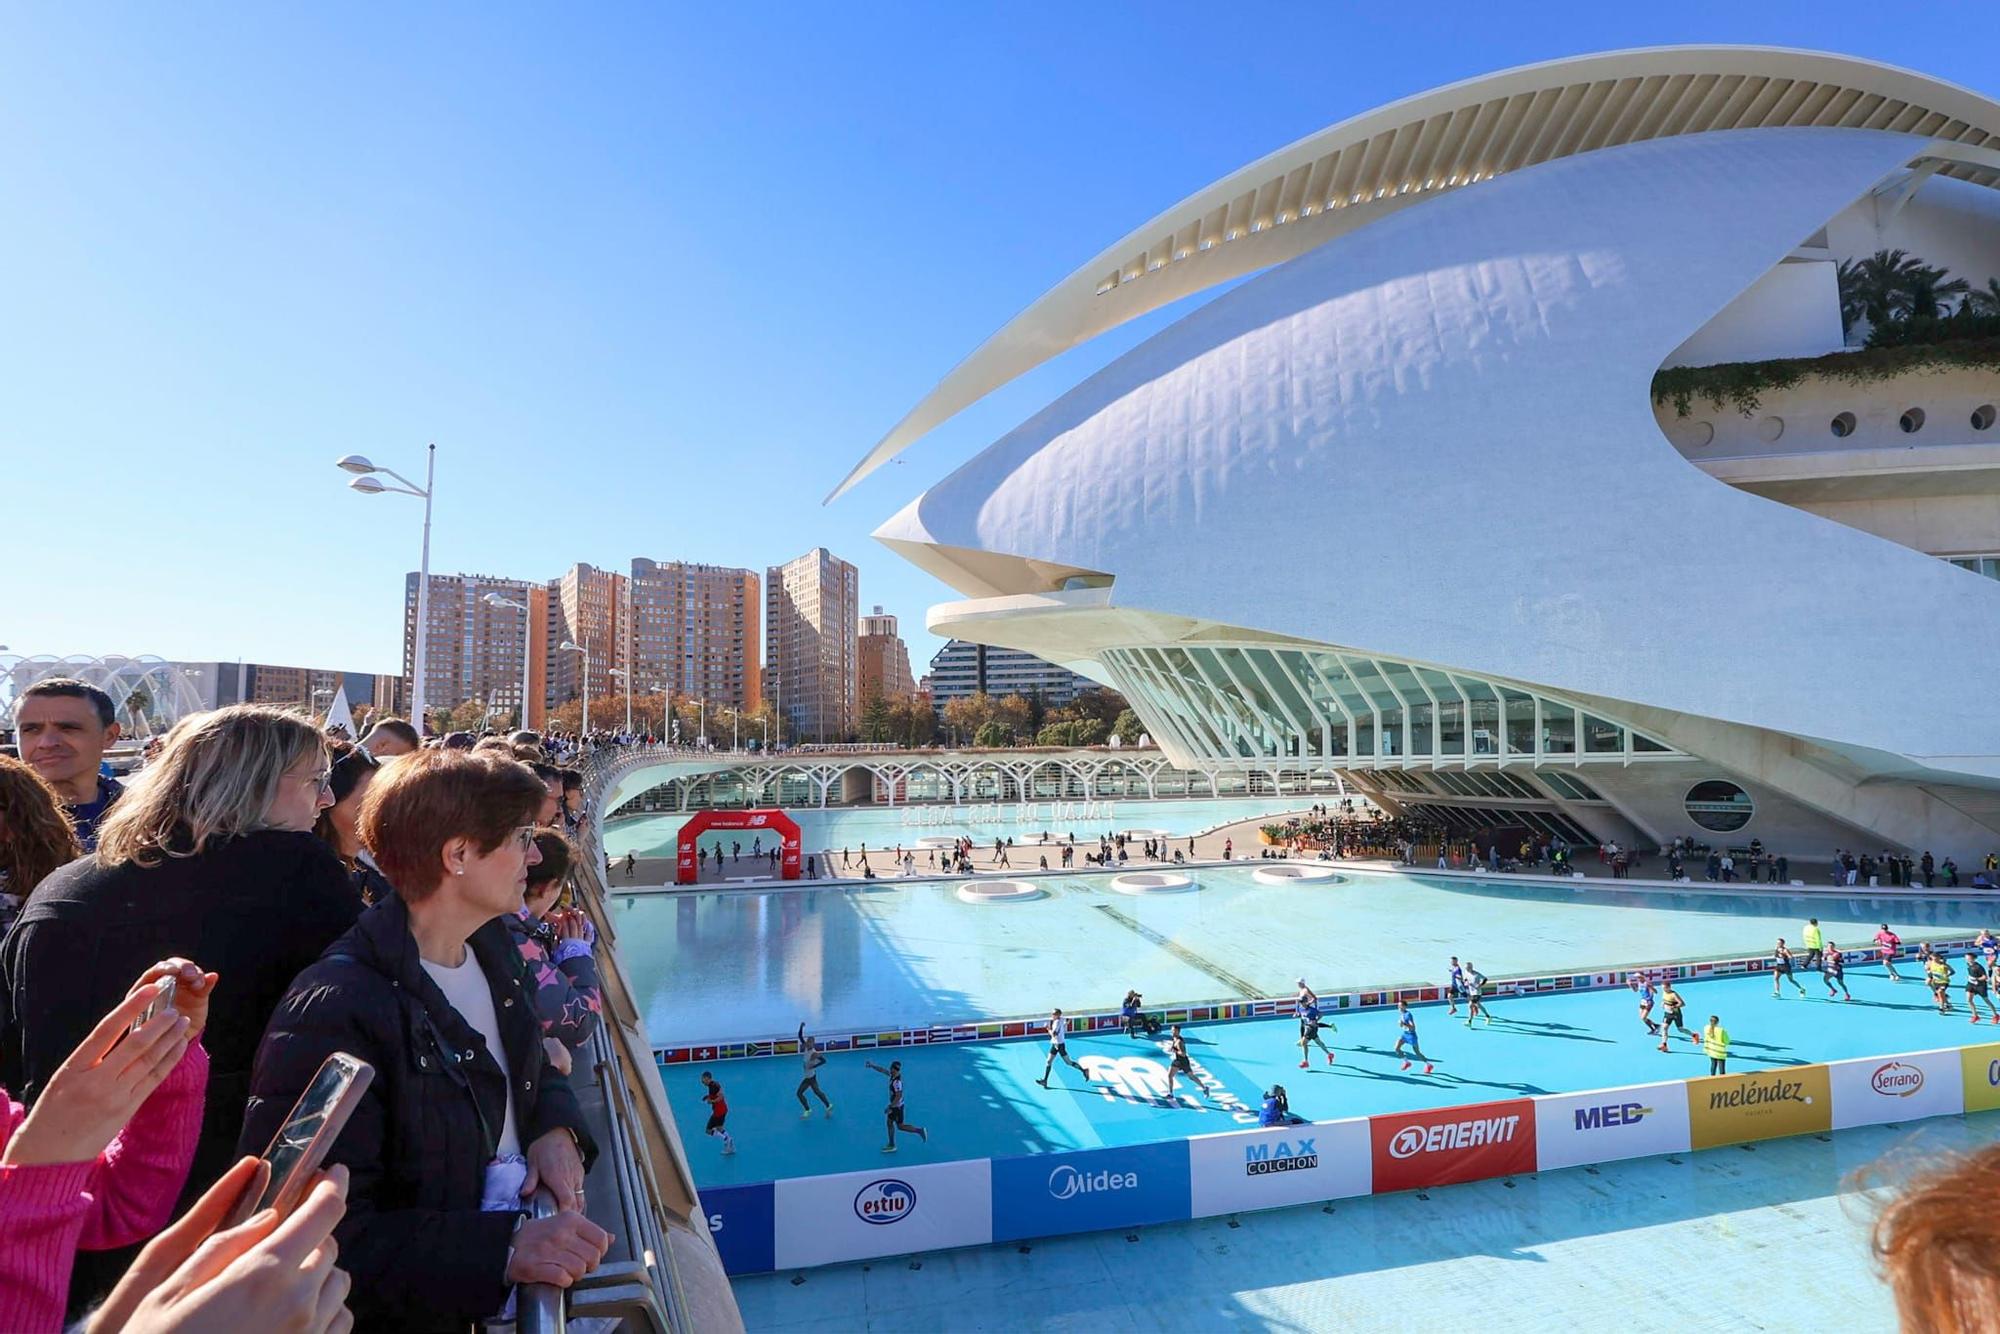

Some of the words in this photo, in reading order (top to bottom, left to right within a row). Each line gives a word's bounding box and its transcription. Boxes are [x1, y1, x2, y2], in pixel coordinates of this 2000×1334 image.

[1877, 1073, 1920, 1088] Serrano
[1425, 1115, 1520, 1152] ENERVIT
[1246, 1138, 1317, 1161] MAX
[1247, 1156, 1317, 1174] COLCHON
[1059, 1169, 1137, 1197] Midea
